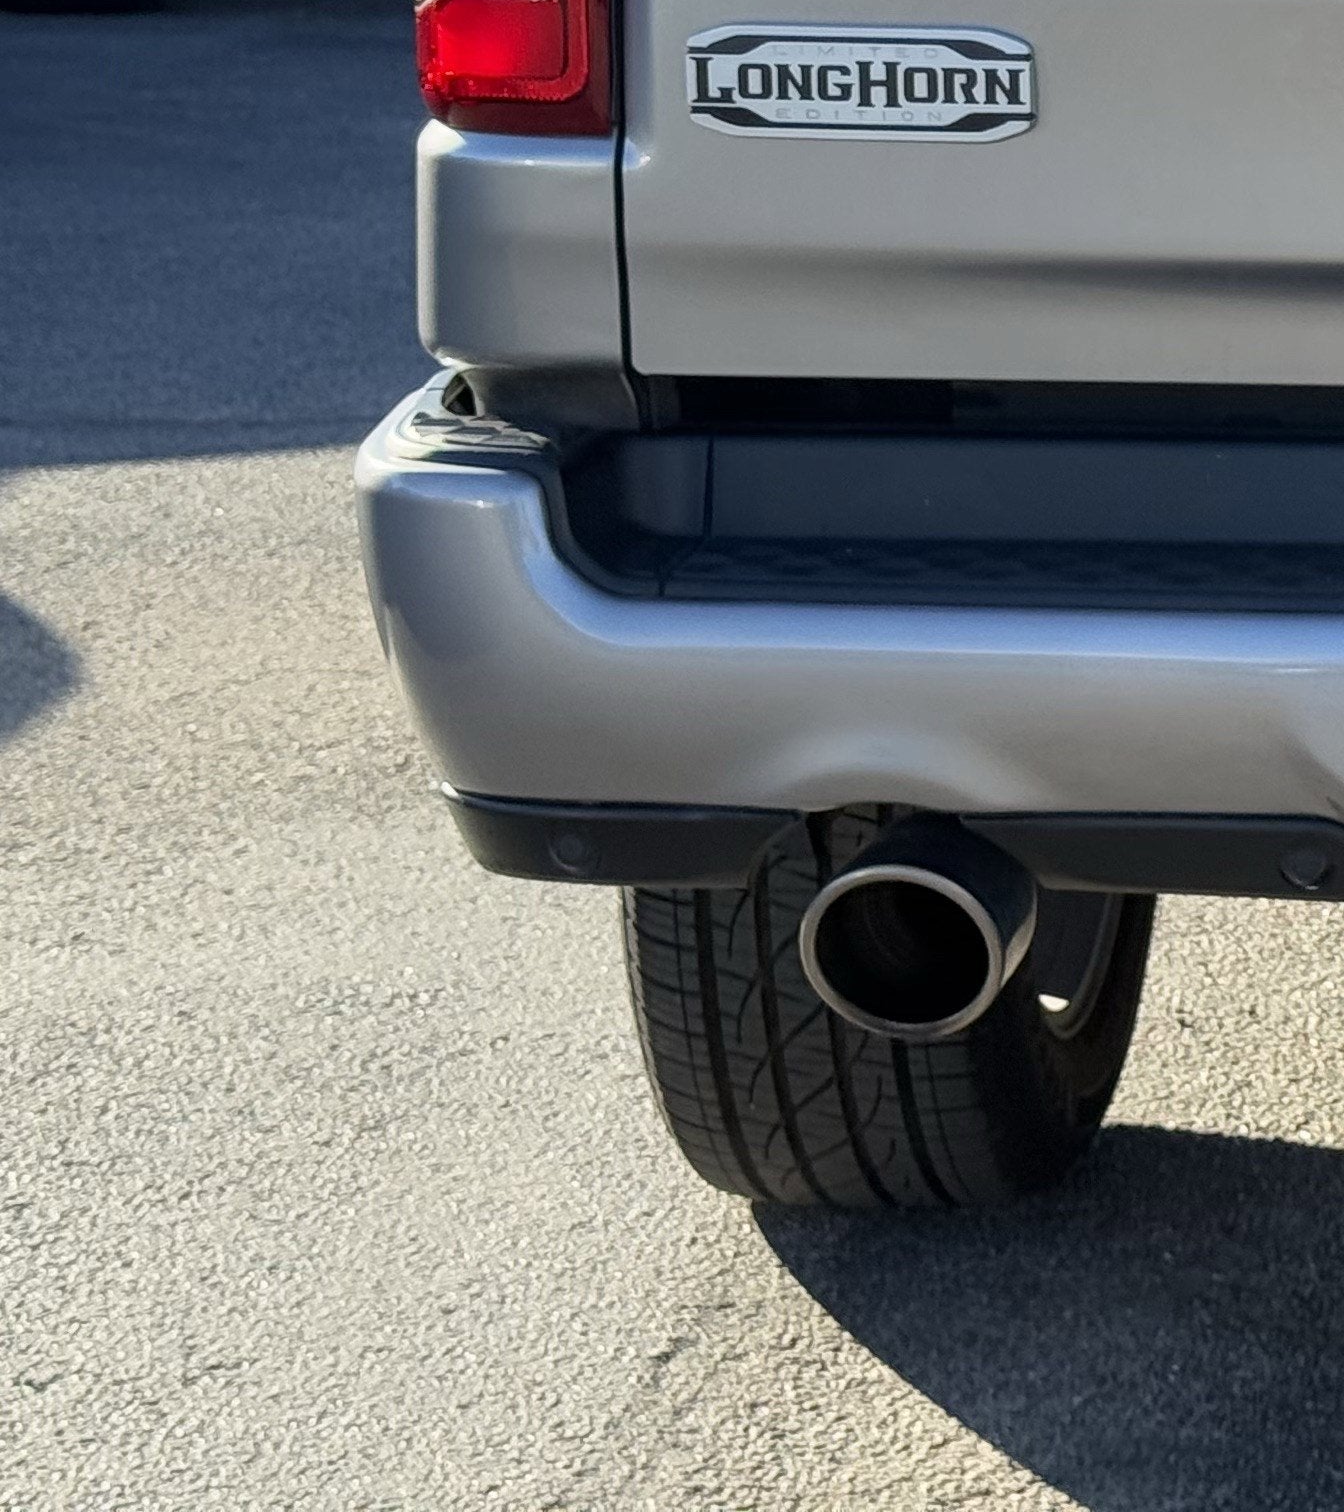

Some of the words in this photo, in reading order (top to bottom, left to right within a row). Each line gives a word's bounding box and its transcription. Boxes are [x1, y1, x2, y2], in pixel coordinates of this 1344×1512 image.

[772, 46, 940, 61] LIMITED
[688, 56, 1026, 108] LONGHORN
[775, 108, 943, 122] EDITION
